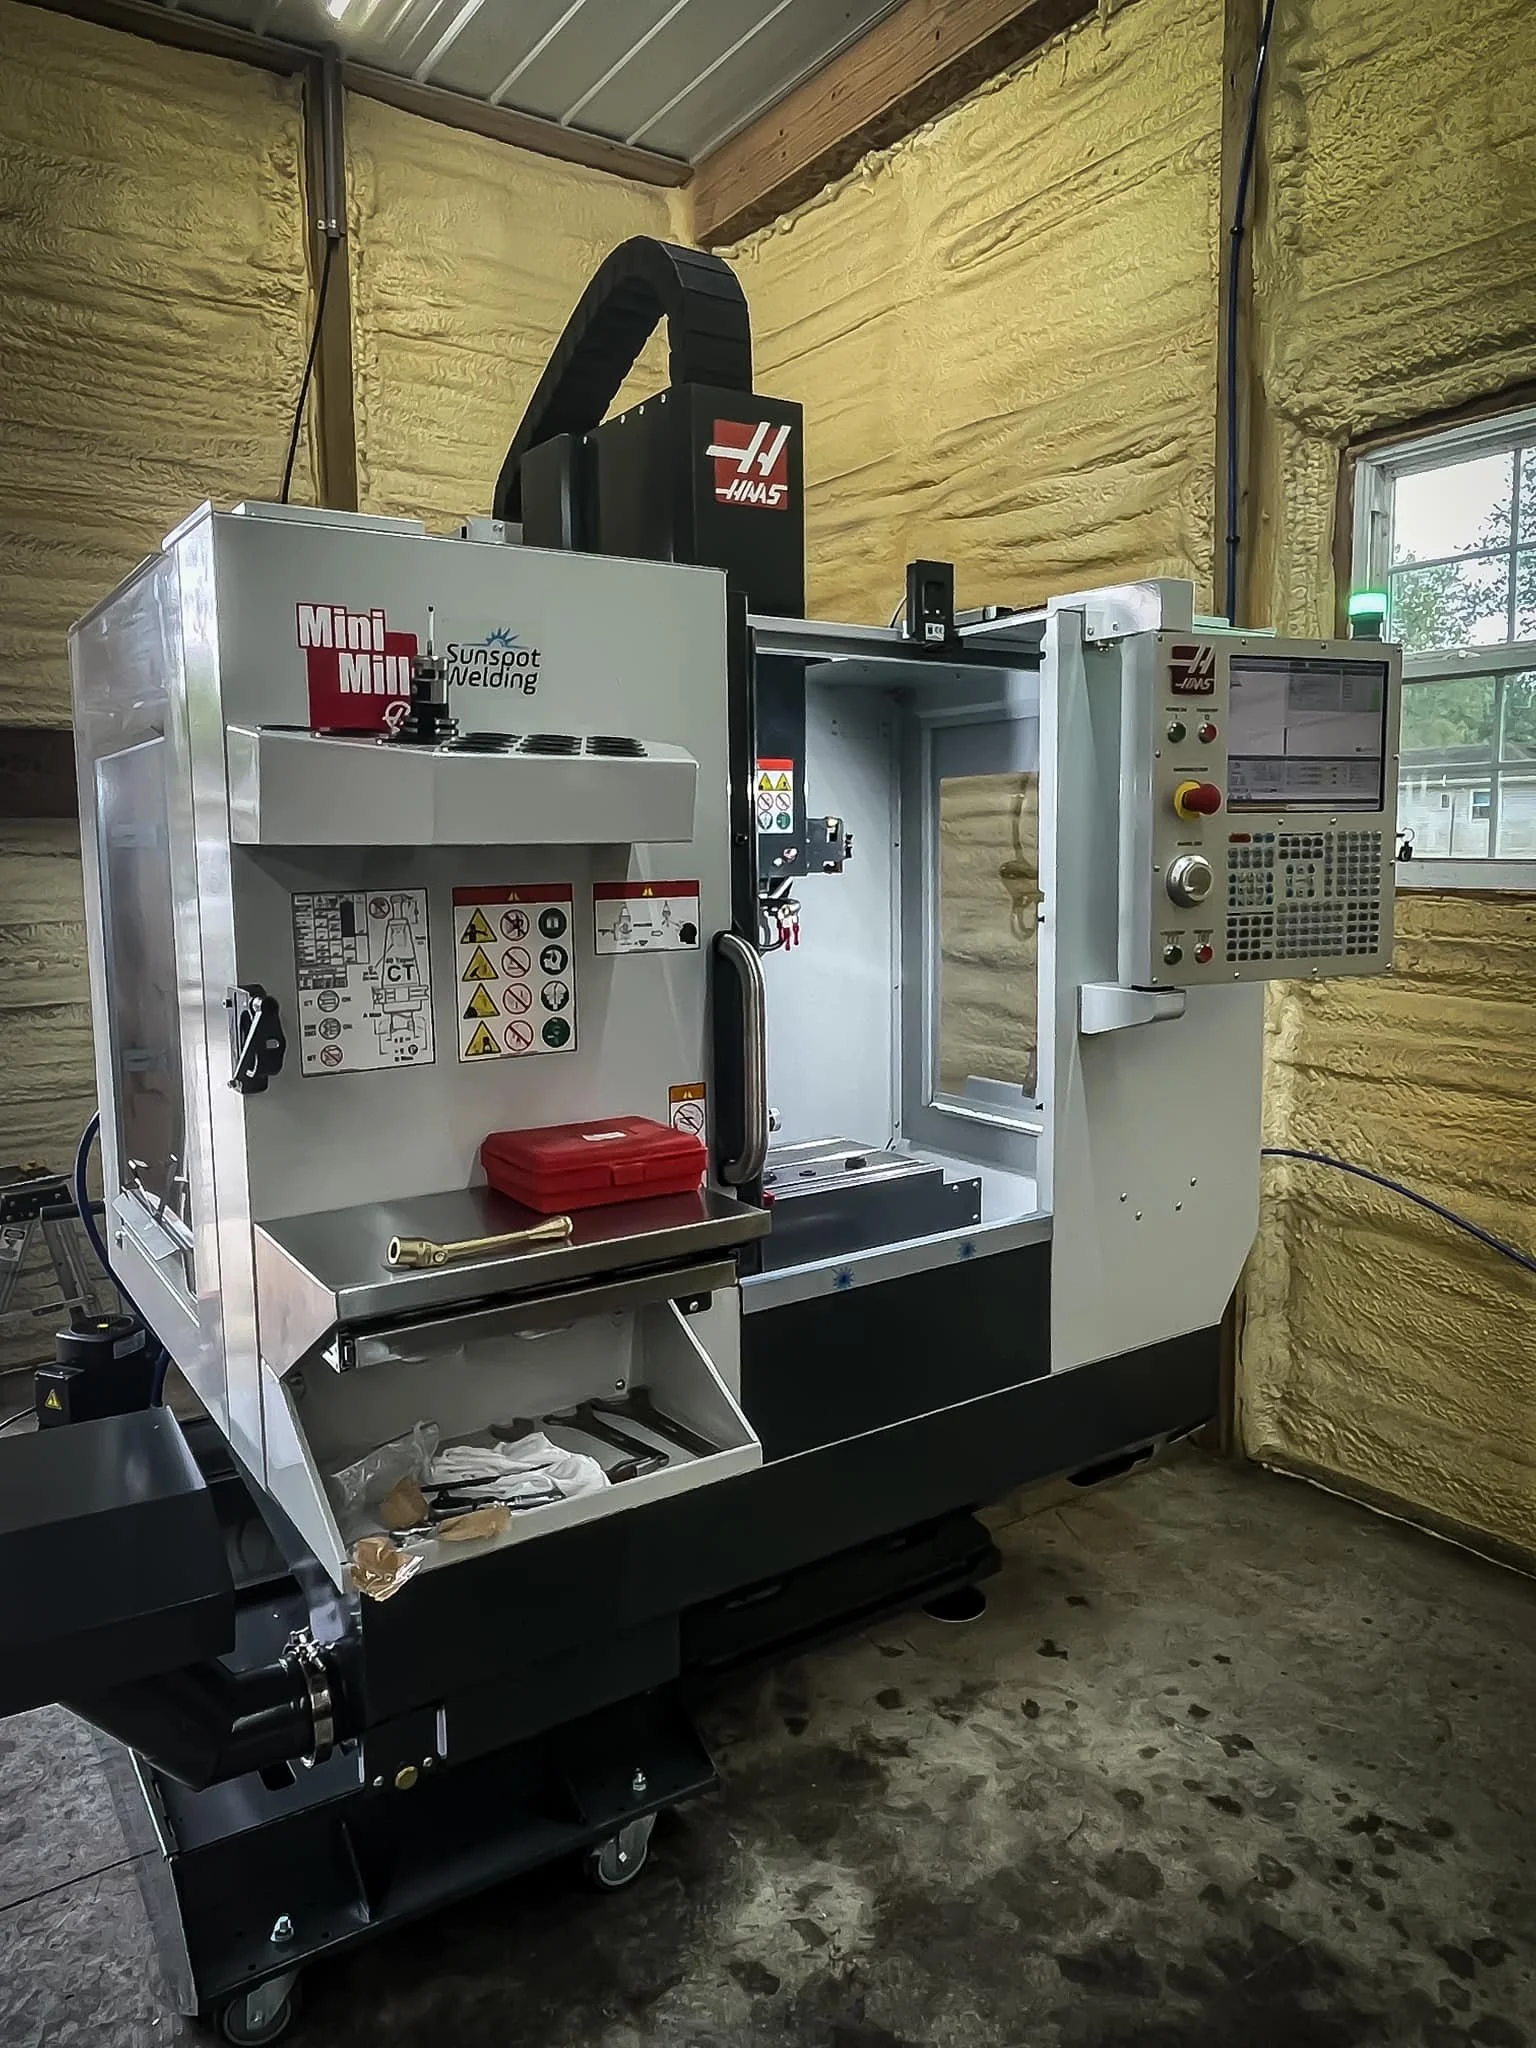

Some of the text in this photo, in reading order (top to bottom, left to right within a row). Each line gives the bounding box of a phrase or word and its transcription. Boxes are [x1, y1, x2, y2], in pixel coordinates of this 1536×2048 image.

[715, 478, 788, 506] HAAS
[298, 604, 386, 652] Mini
[446, 643, 541, 674] Sunspot
[338, 652, 411, 697] Mill
[448, 666, 539, 695] Welding
[387, 964, 415, 983] CT
